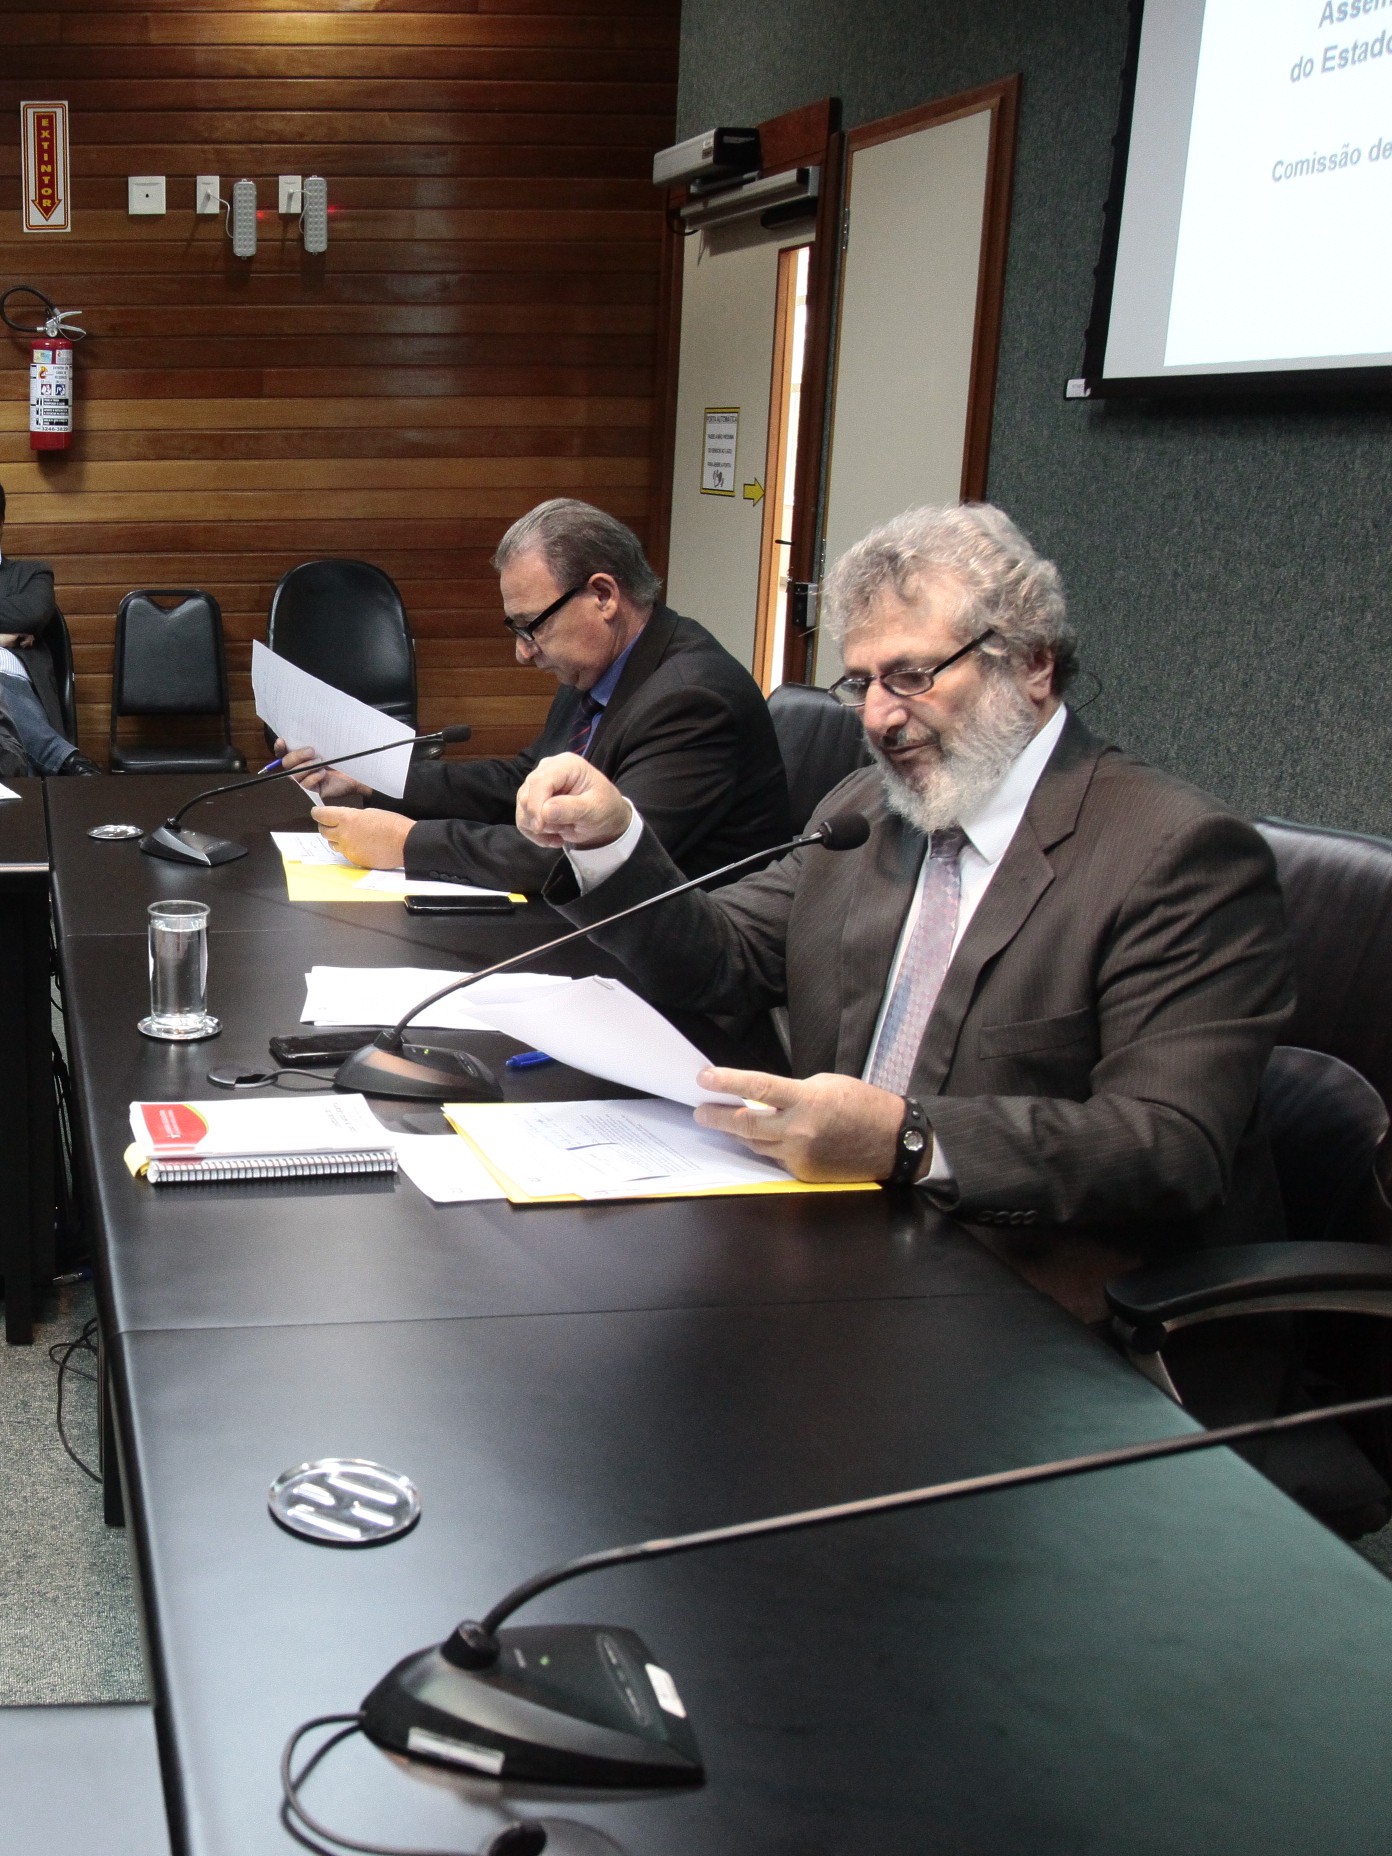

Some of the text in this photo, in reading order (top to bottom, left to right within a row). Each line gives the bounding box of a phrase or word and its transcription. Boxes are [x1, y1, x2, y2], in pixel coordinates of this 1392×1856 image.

[1290, 56, 1315, 83] do
[40, 118, 52, 207] EXTINTOR
[1272, 136, 1392, 182] Comissão de
